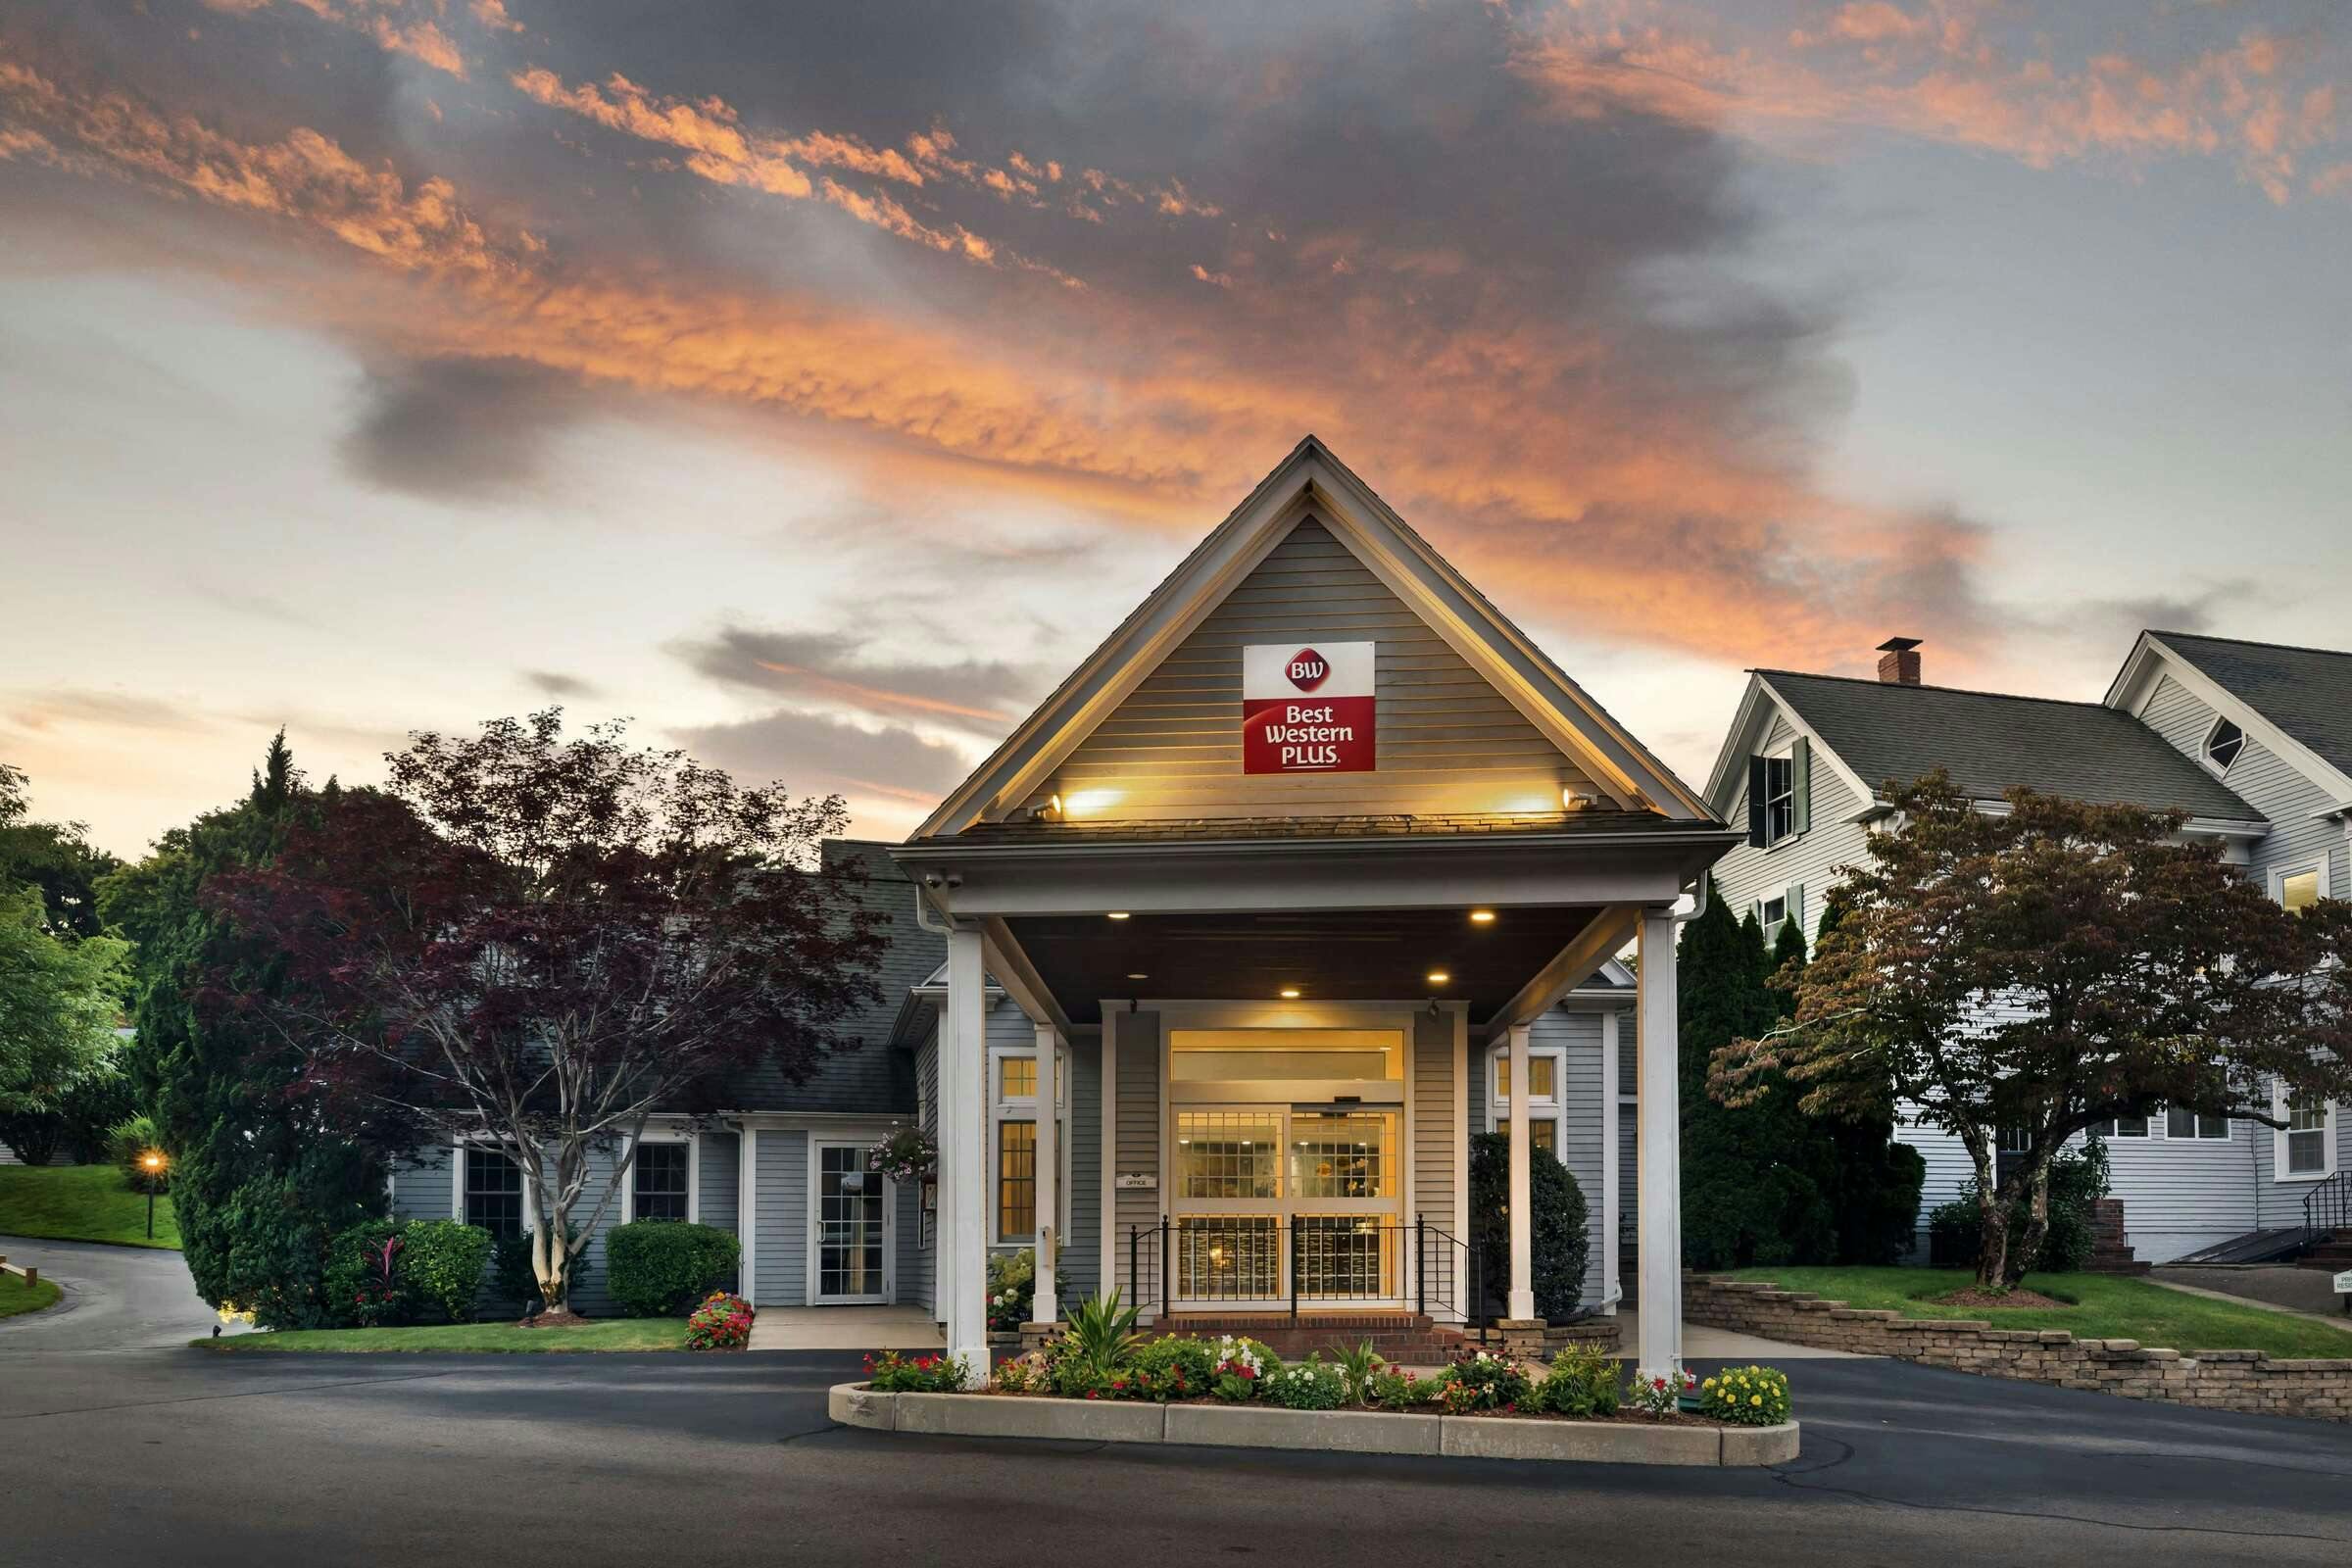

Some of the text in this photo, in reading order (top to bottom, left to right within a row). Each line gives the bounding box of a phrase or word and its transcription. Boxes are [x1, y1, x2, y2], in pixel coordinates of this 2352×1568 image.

[1291, 662, 1324, 679] BW
[1286, 705, 1334, 724] Best
[1265, 724, 1354, 744] Western
